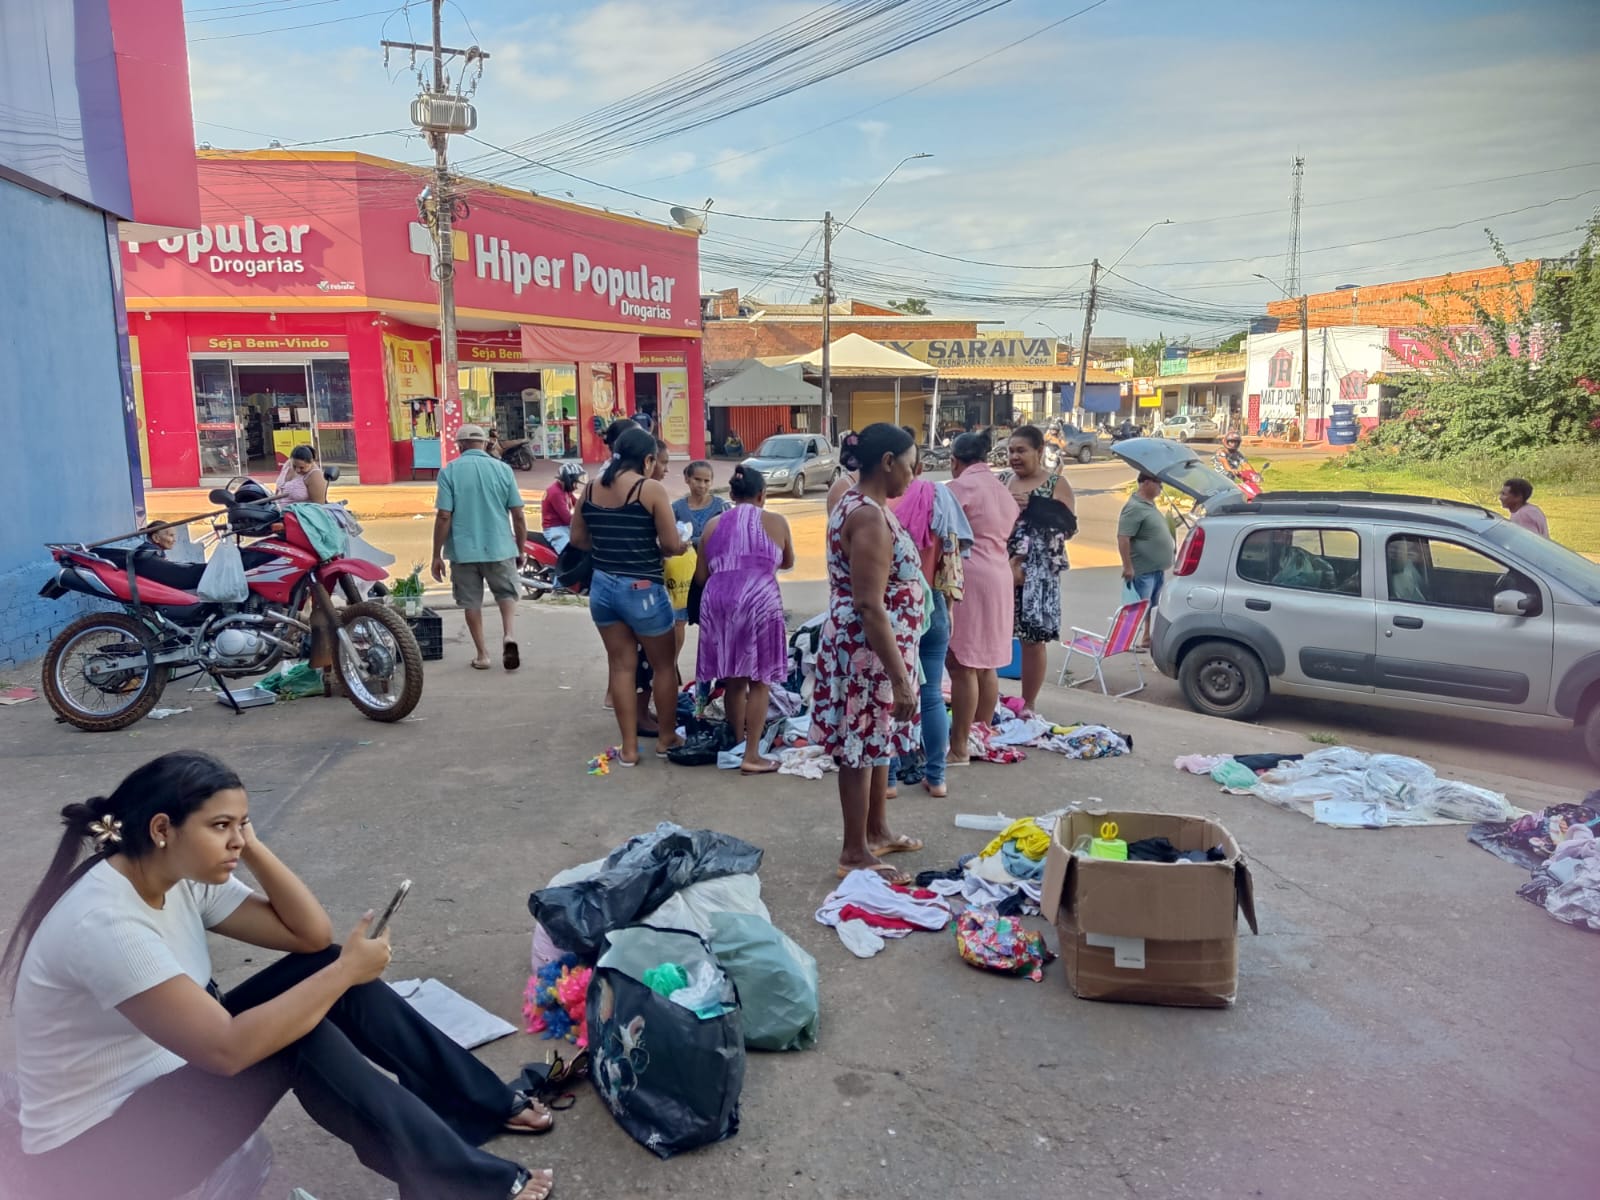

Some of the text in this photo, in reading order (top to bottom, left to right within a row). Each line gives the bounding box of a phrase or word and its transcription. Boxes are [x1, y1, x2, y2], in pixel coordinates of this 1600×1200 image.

[209, 255, 305, 278] Drogarias
[475, 234, 676, 305] Hiper Popular
[620, 299, 671, 322] Drogarias
[208, 337, 329, 351] Seja Bem-Vindo
[471, 346, 497, 361] Seja
[927, 339, 1052, 359] SARAIVA
